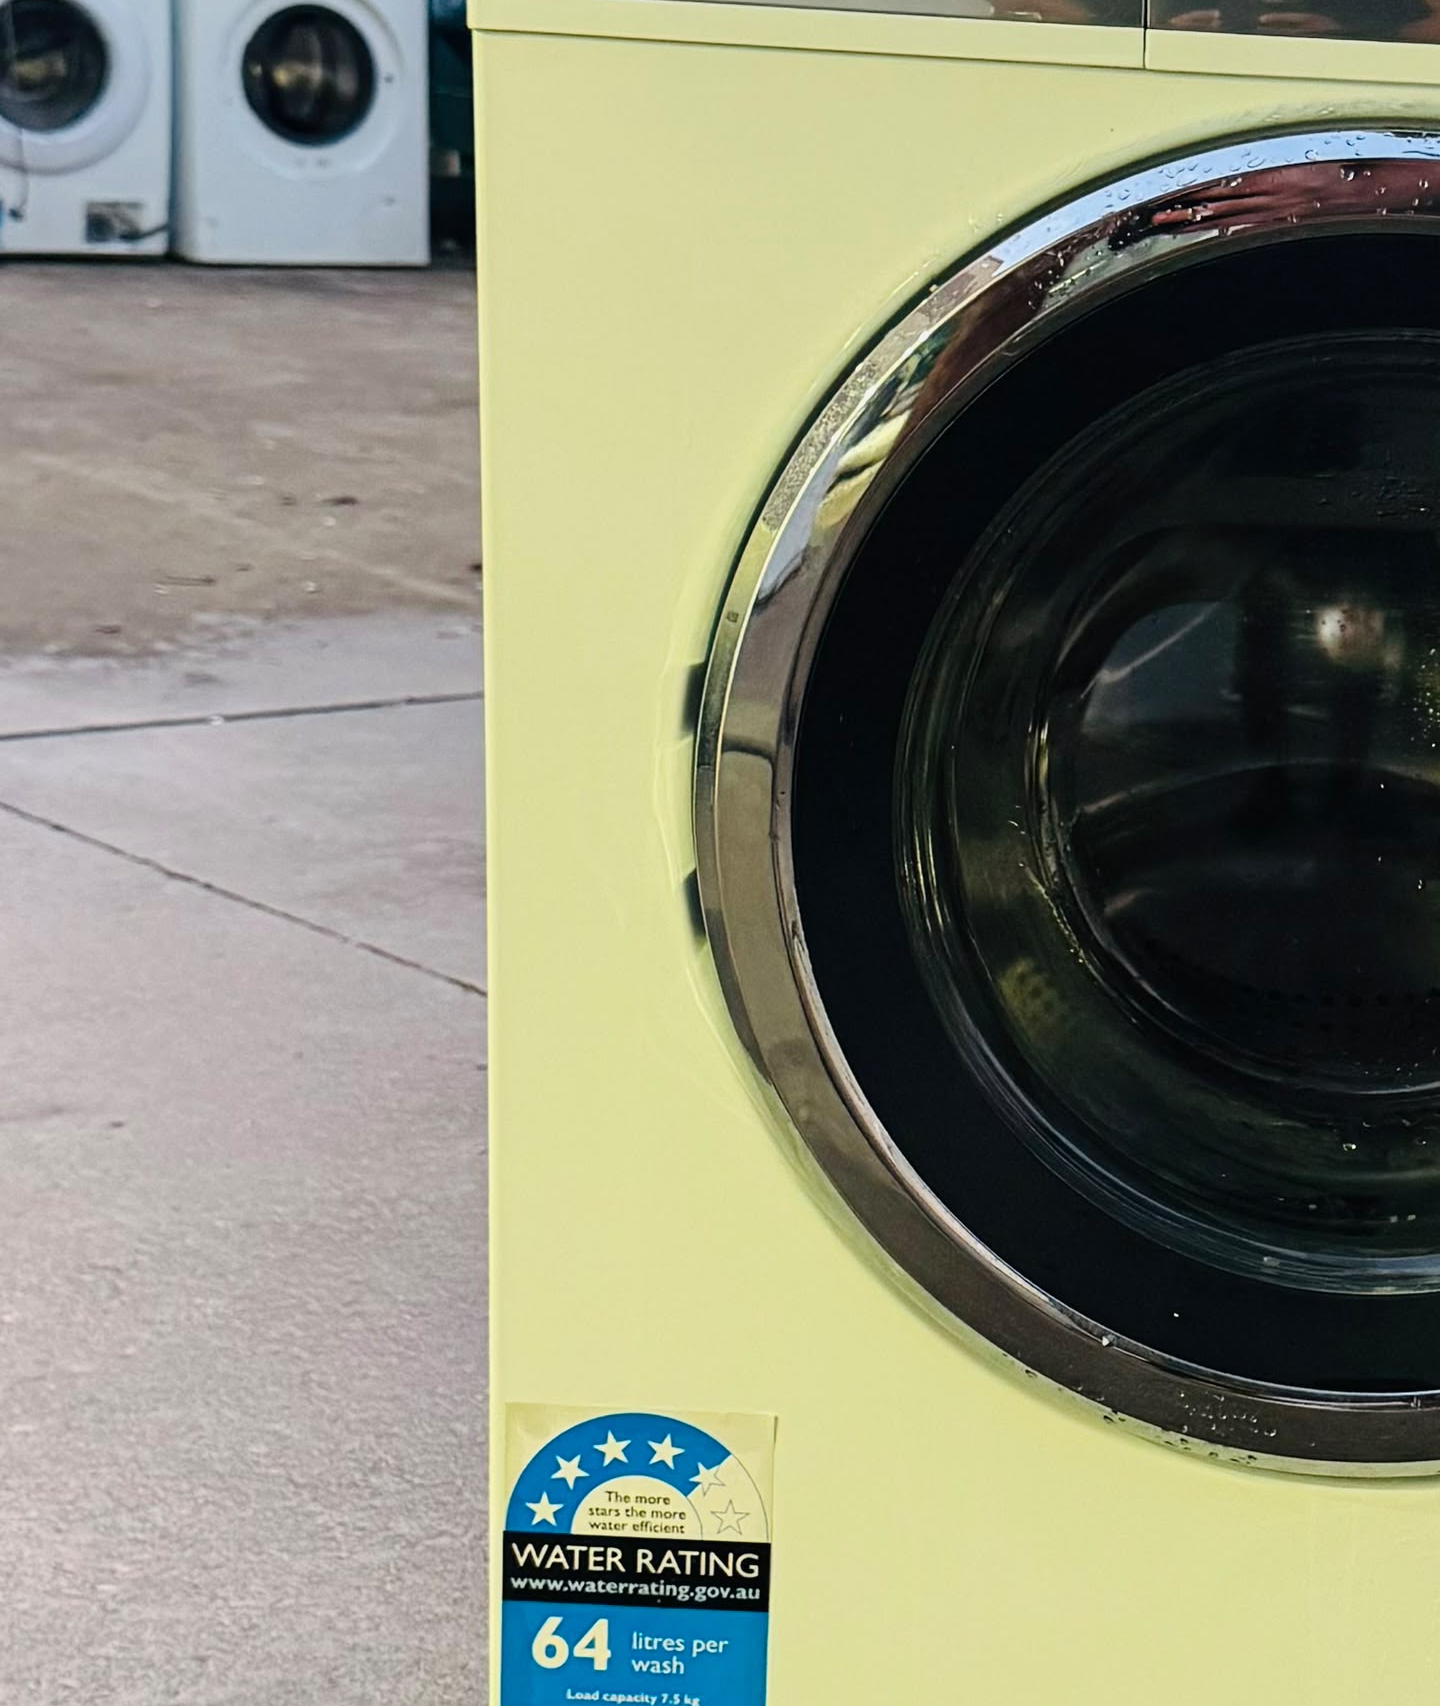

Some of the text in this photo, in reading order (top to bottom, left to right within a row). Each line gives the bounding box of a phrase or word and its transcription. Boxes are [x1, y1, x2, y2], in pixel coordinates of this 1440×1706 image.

[605, 1490, 671, 1505] The more
[588, 1507, 686, 1521] stars the more
[588, 1519, 686, 1535] water efficient
[511, 1542, 759, 1578] WATER RATING
[510, 1576, 761, 1602] www.waterrating.gov.au
[530, 1615, 728, 1672] 64 litres per
[631, 1656, 685, 1674] wash
[566, 1689, 600, 1702] Load
[602, 1691, 657, 1705] capacity
[661, 1693, 681, 1705] 7.5
